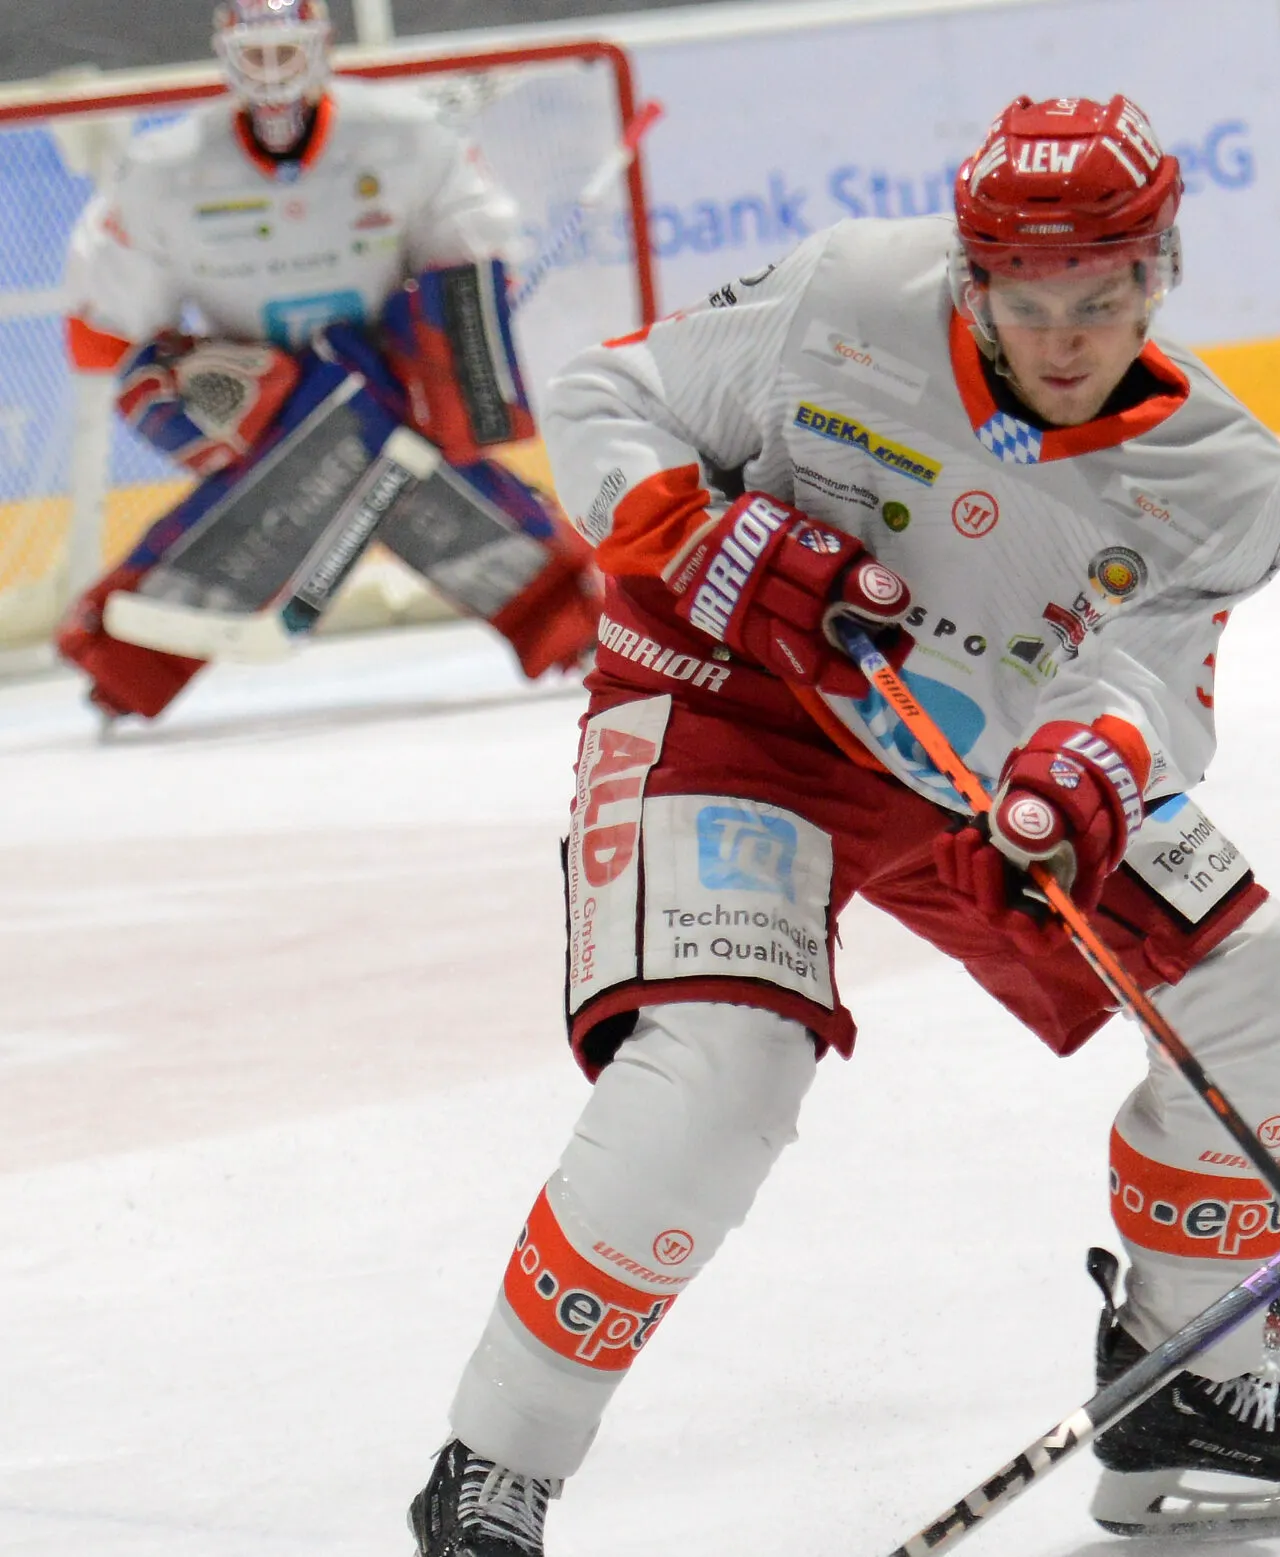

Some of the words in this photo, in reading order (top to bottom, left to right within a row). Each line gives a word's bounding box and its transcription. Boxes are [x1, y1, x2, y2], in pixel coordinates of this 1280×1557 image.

[1018, 142, 1081, 173] LEW
[833, 339, 873, 367] koch
[796, 405, 870, 451] EDEKA
[1134, 493, 1171, 522] koch
[583, 728, 657, 888] ALD
[1184, 868, 1214, 894] in
[580, 897, 597, 983] GmbH
[662, 904, 819, 957] Technologie
[674, 940, 699, 959] in
[709, 938, 819, 983] Qualität
[555, 1288, 672, 1362] ept
[1188, 1438, 1263, 1465] BAUER
